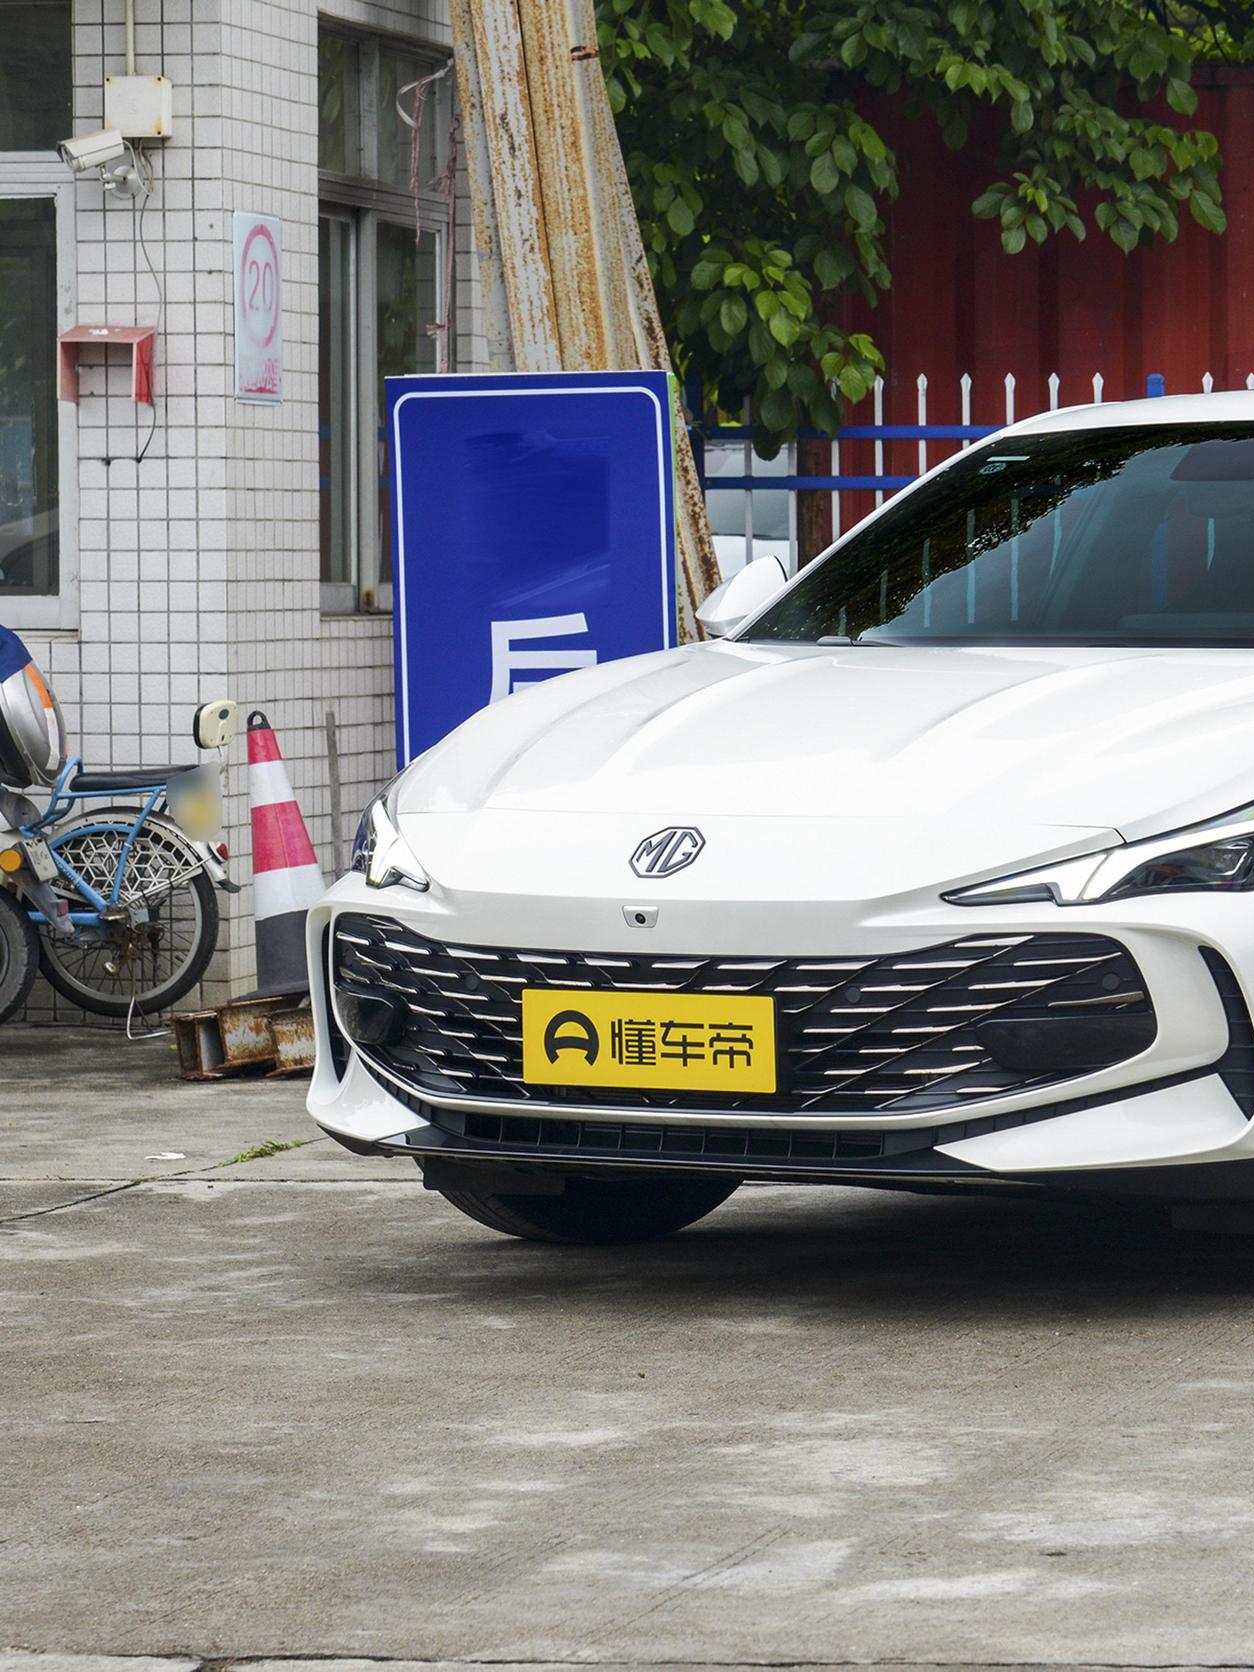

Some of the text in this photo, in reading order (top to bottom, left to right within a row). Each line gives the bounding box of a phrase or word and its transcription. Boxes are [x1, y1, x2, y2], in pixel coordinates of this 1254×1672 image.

[249, 260, 275, 312] 20
[634, 829, 700, 874] MG
[611, 1018, 754, 1069] 懂车帝
